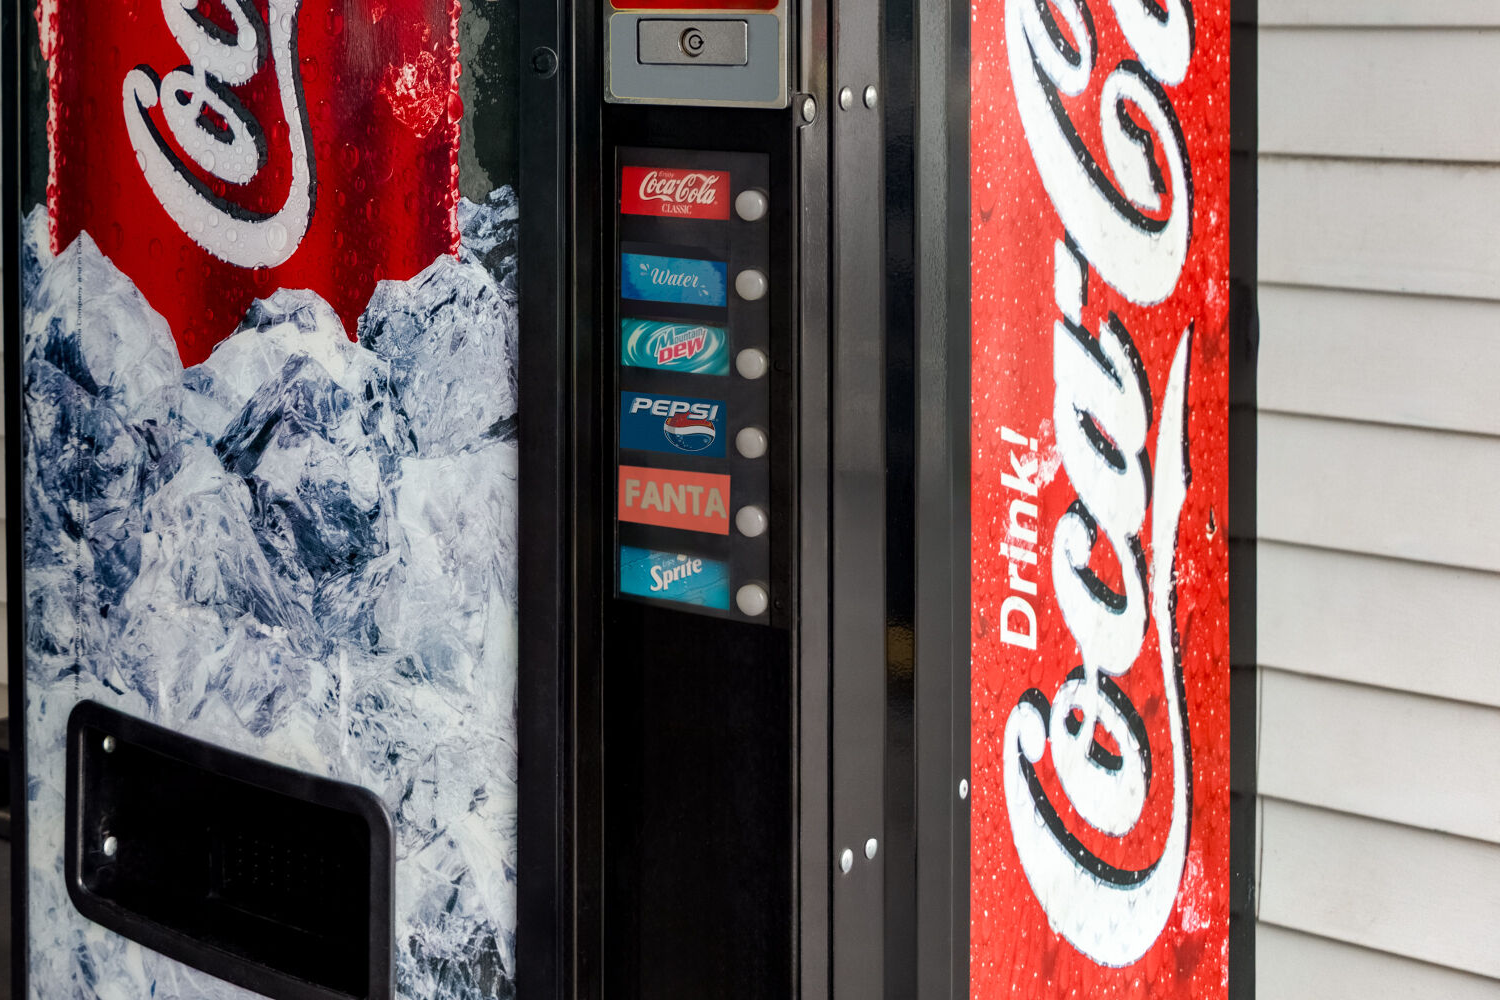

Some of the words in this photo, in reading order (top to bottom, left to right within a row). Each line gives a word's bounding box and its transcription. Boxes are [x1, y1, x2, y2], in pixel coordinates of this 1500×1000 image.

[639, 171, 719, 204] Coca-Cola
[662, 204, 692, 215] CLASSIC
[651, 267, 699, 288] Water
[655, 327, 705, 357] Mountain
[630, 398, 719, 420] PEPSI
[625, 479, 727, 519] FANTA
[1001, 426, 1038, 650] Drink!
[650, 554, 703, 592] Sprite
